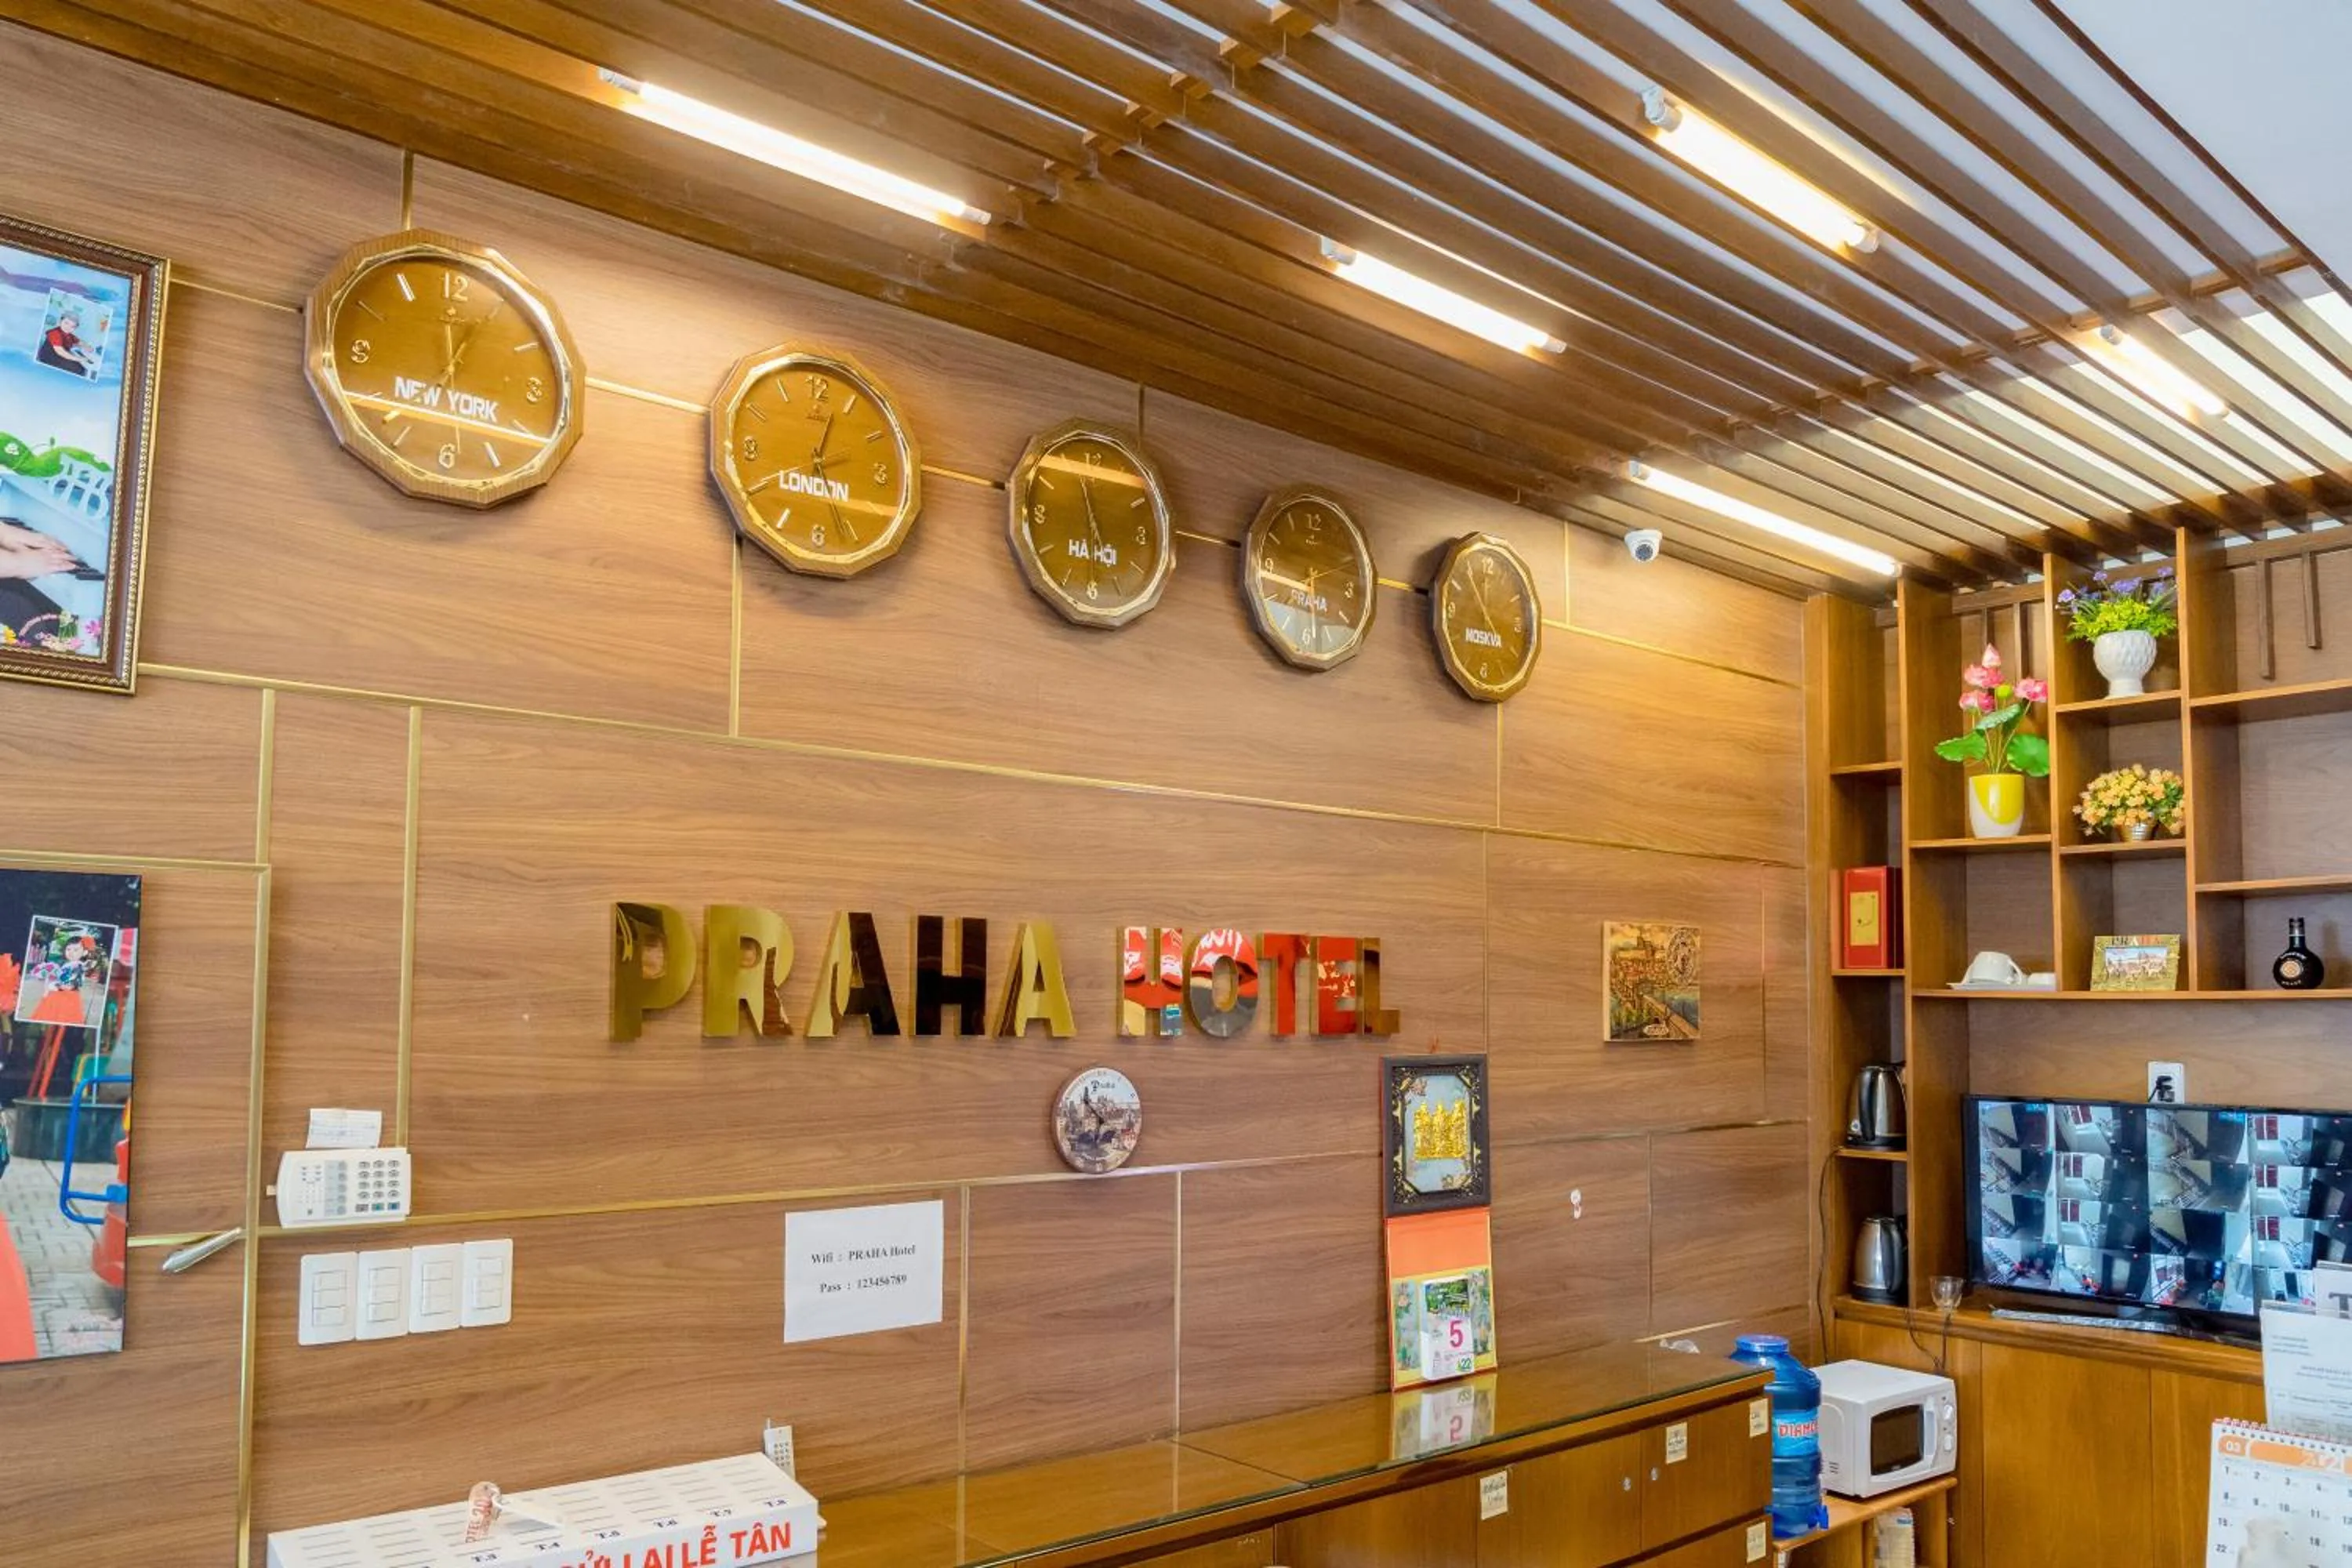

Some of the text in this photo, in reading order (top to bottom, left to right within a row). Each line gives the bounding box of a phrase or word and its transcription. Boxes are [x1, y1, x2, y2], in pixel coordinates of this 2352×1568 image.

[445, 272, 469, 302] 12
[394, 376, 499, 423] NEW YORK
[804, 376, 829, 401] 12
[438, 443, 456, 469] 6
[778, 470, 850, 503] LONDON
[1305, 514, 1322, 531] 12
[811, 524, 826, 547] 6
[1301, 627, 1311, 645] 6
[1465, 626, 1503, 648] MOSKVA
[610, 902, 1400, 1041] PRAHA HOTEL
[811, 1251, 834, 1265] Wifi
[848, 1247, 888, 1261] PRAHA
[890, 1244, 916, 1257] Hotel
[819, 1283, 842, 1294] Pass
[857, 1274, 908, 1290] 123456789
[1450, 1319, 1464, 1348] 5
[681, 1524, 717, 1567] LỄ
[729, 1522, 792, 1559] TÂN
